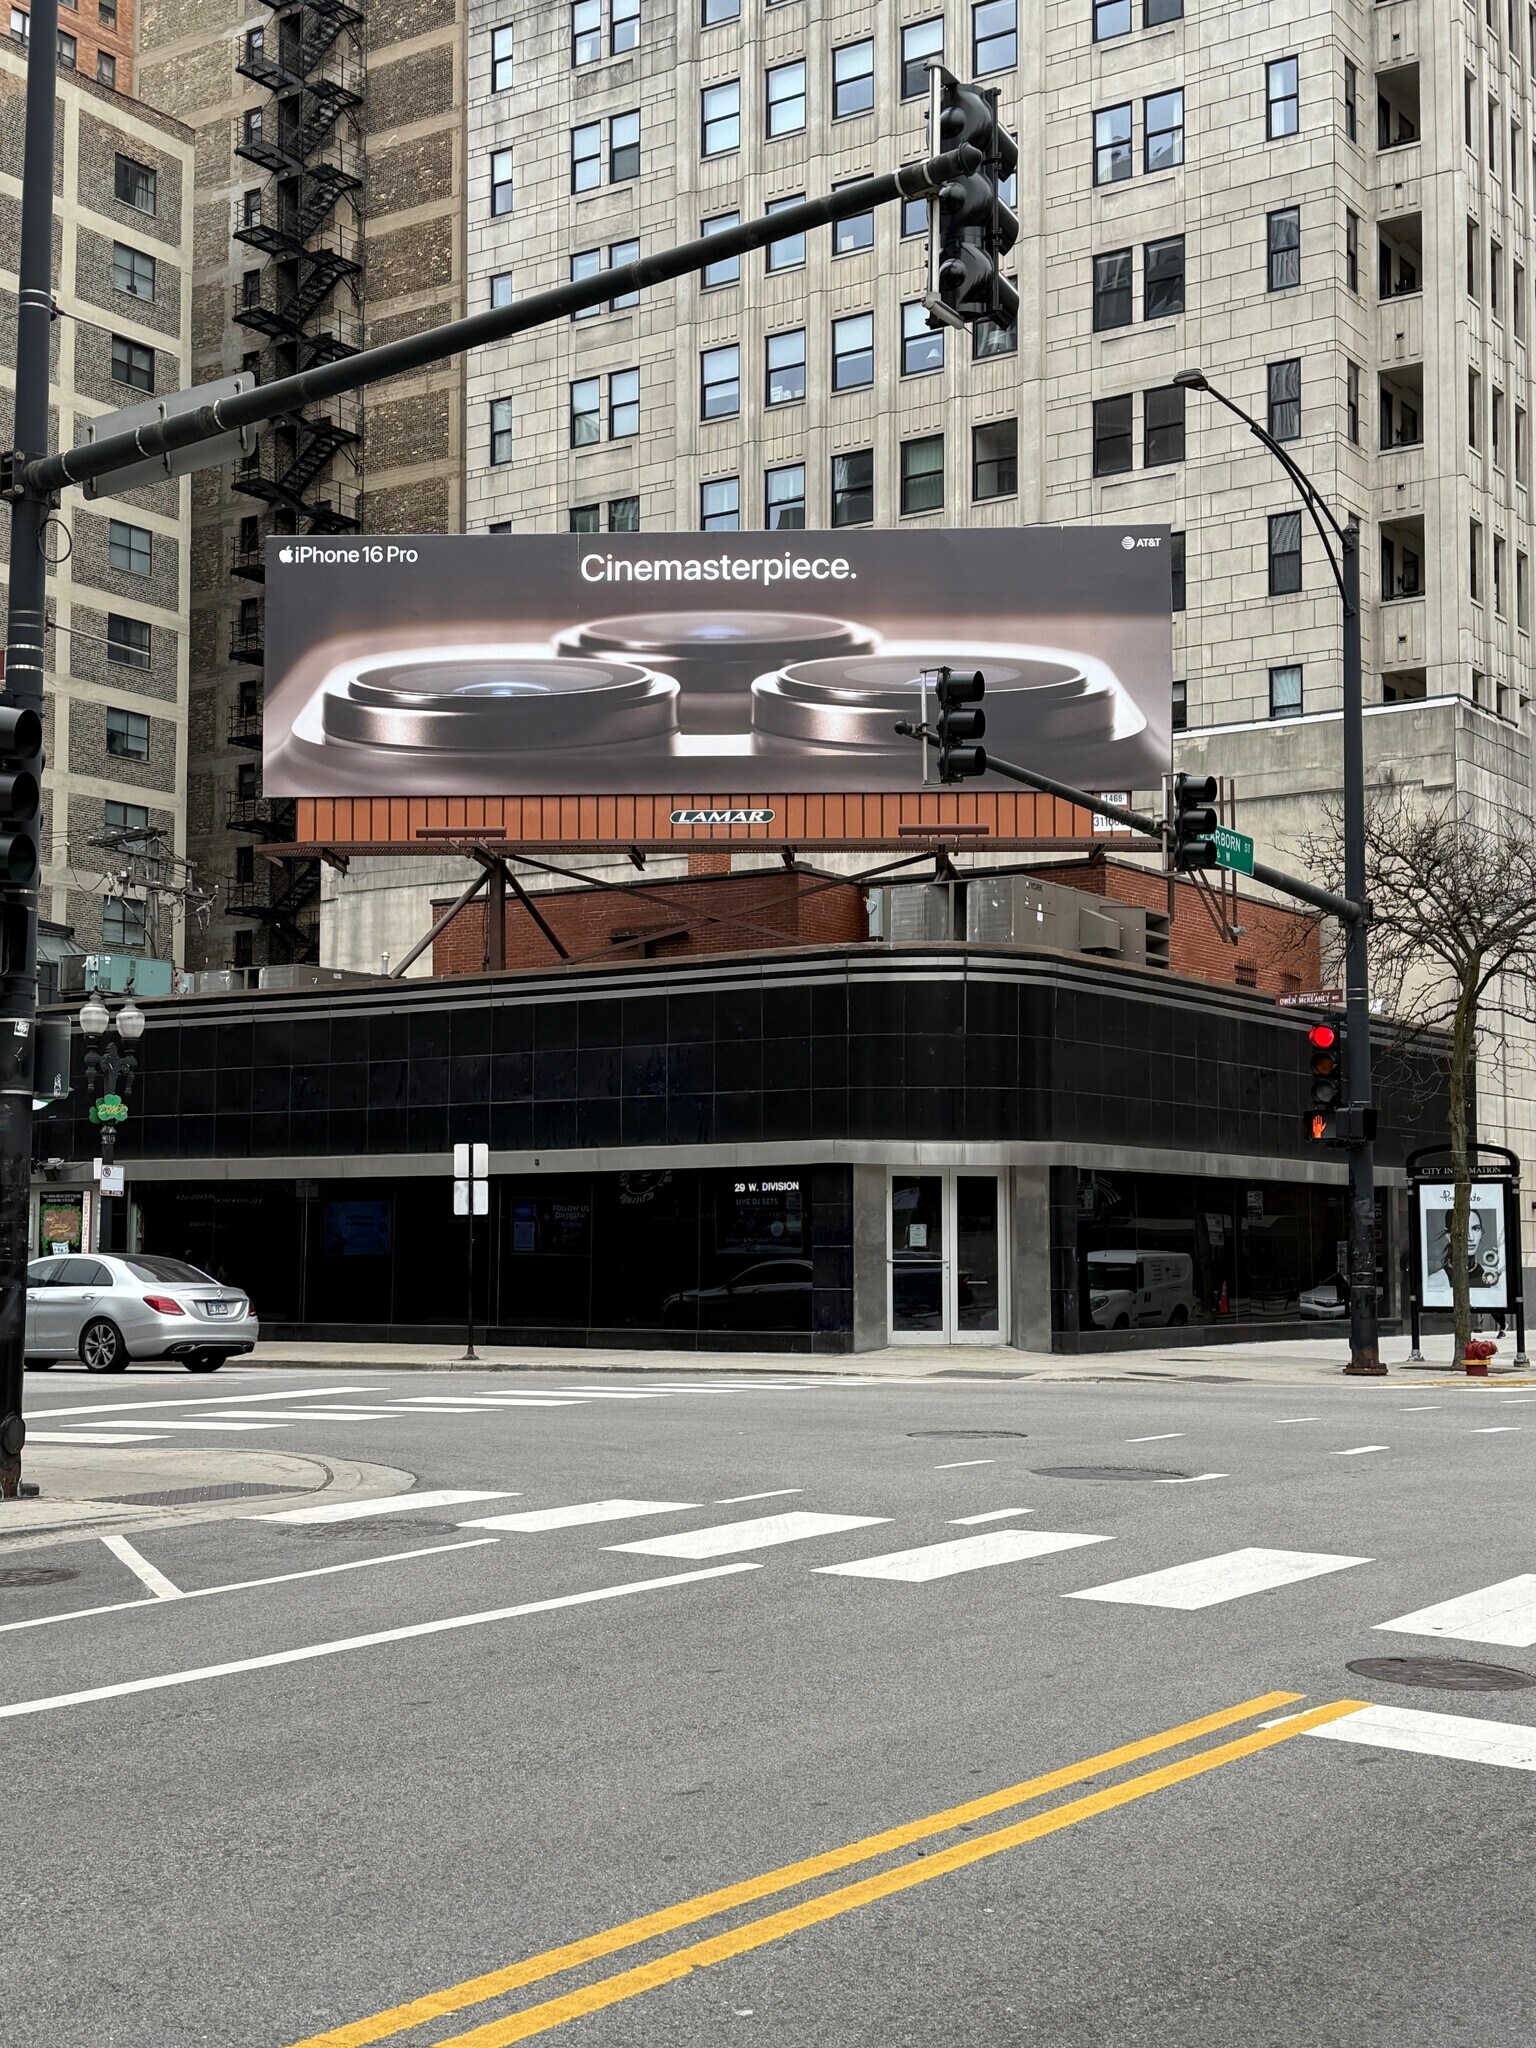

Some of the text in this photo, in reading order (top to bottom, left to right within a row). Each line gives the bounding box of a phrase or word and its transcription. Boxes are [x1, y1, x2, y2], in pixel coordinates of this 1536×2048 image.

[1136, 538, 1162, 547] AT&T
[295, 545, 418, 563] iPhone 16 Pro
[580, 551, 858, 585] Cinemasterpiece.
[679, 811, 765, 822] LAMAR
[1279, 997, 1297, 1006] OWEN
[1422, 1166, 1501, 1175] CITY INMATION
[734, 1181, 800, 1193] 29 W. DIVISION
[736, 1198, 751, 1206] LIVE
[552, 1204, 580, 1212] FOLLOW
